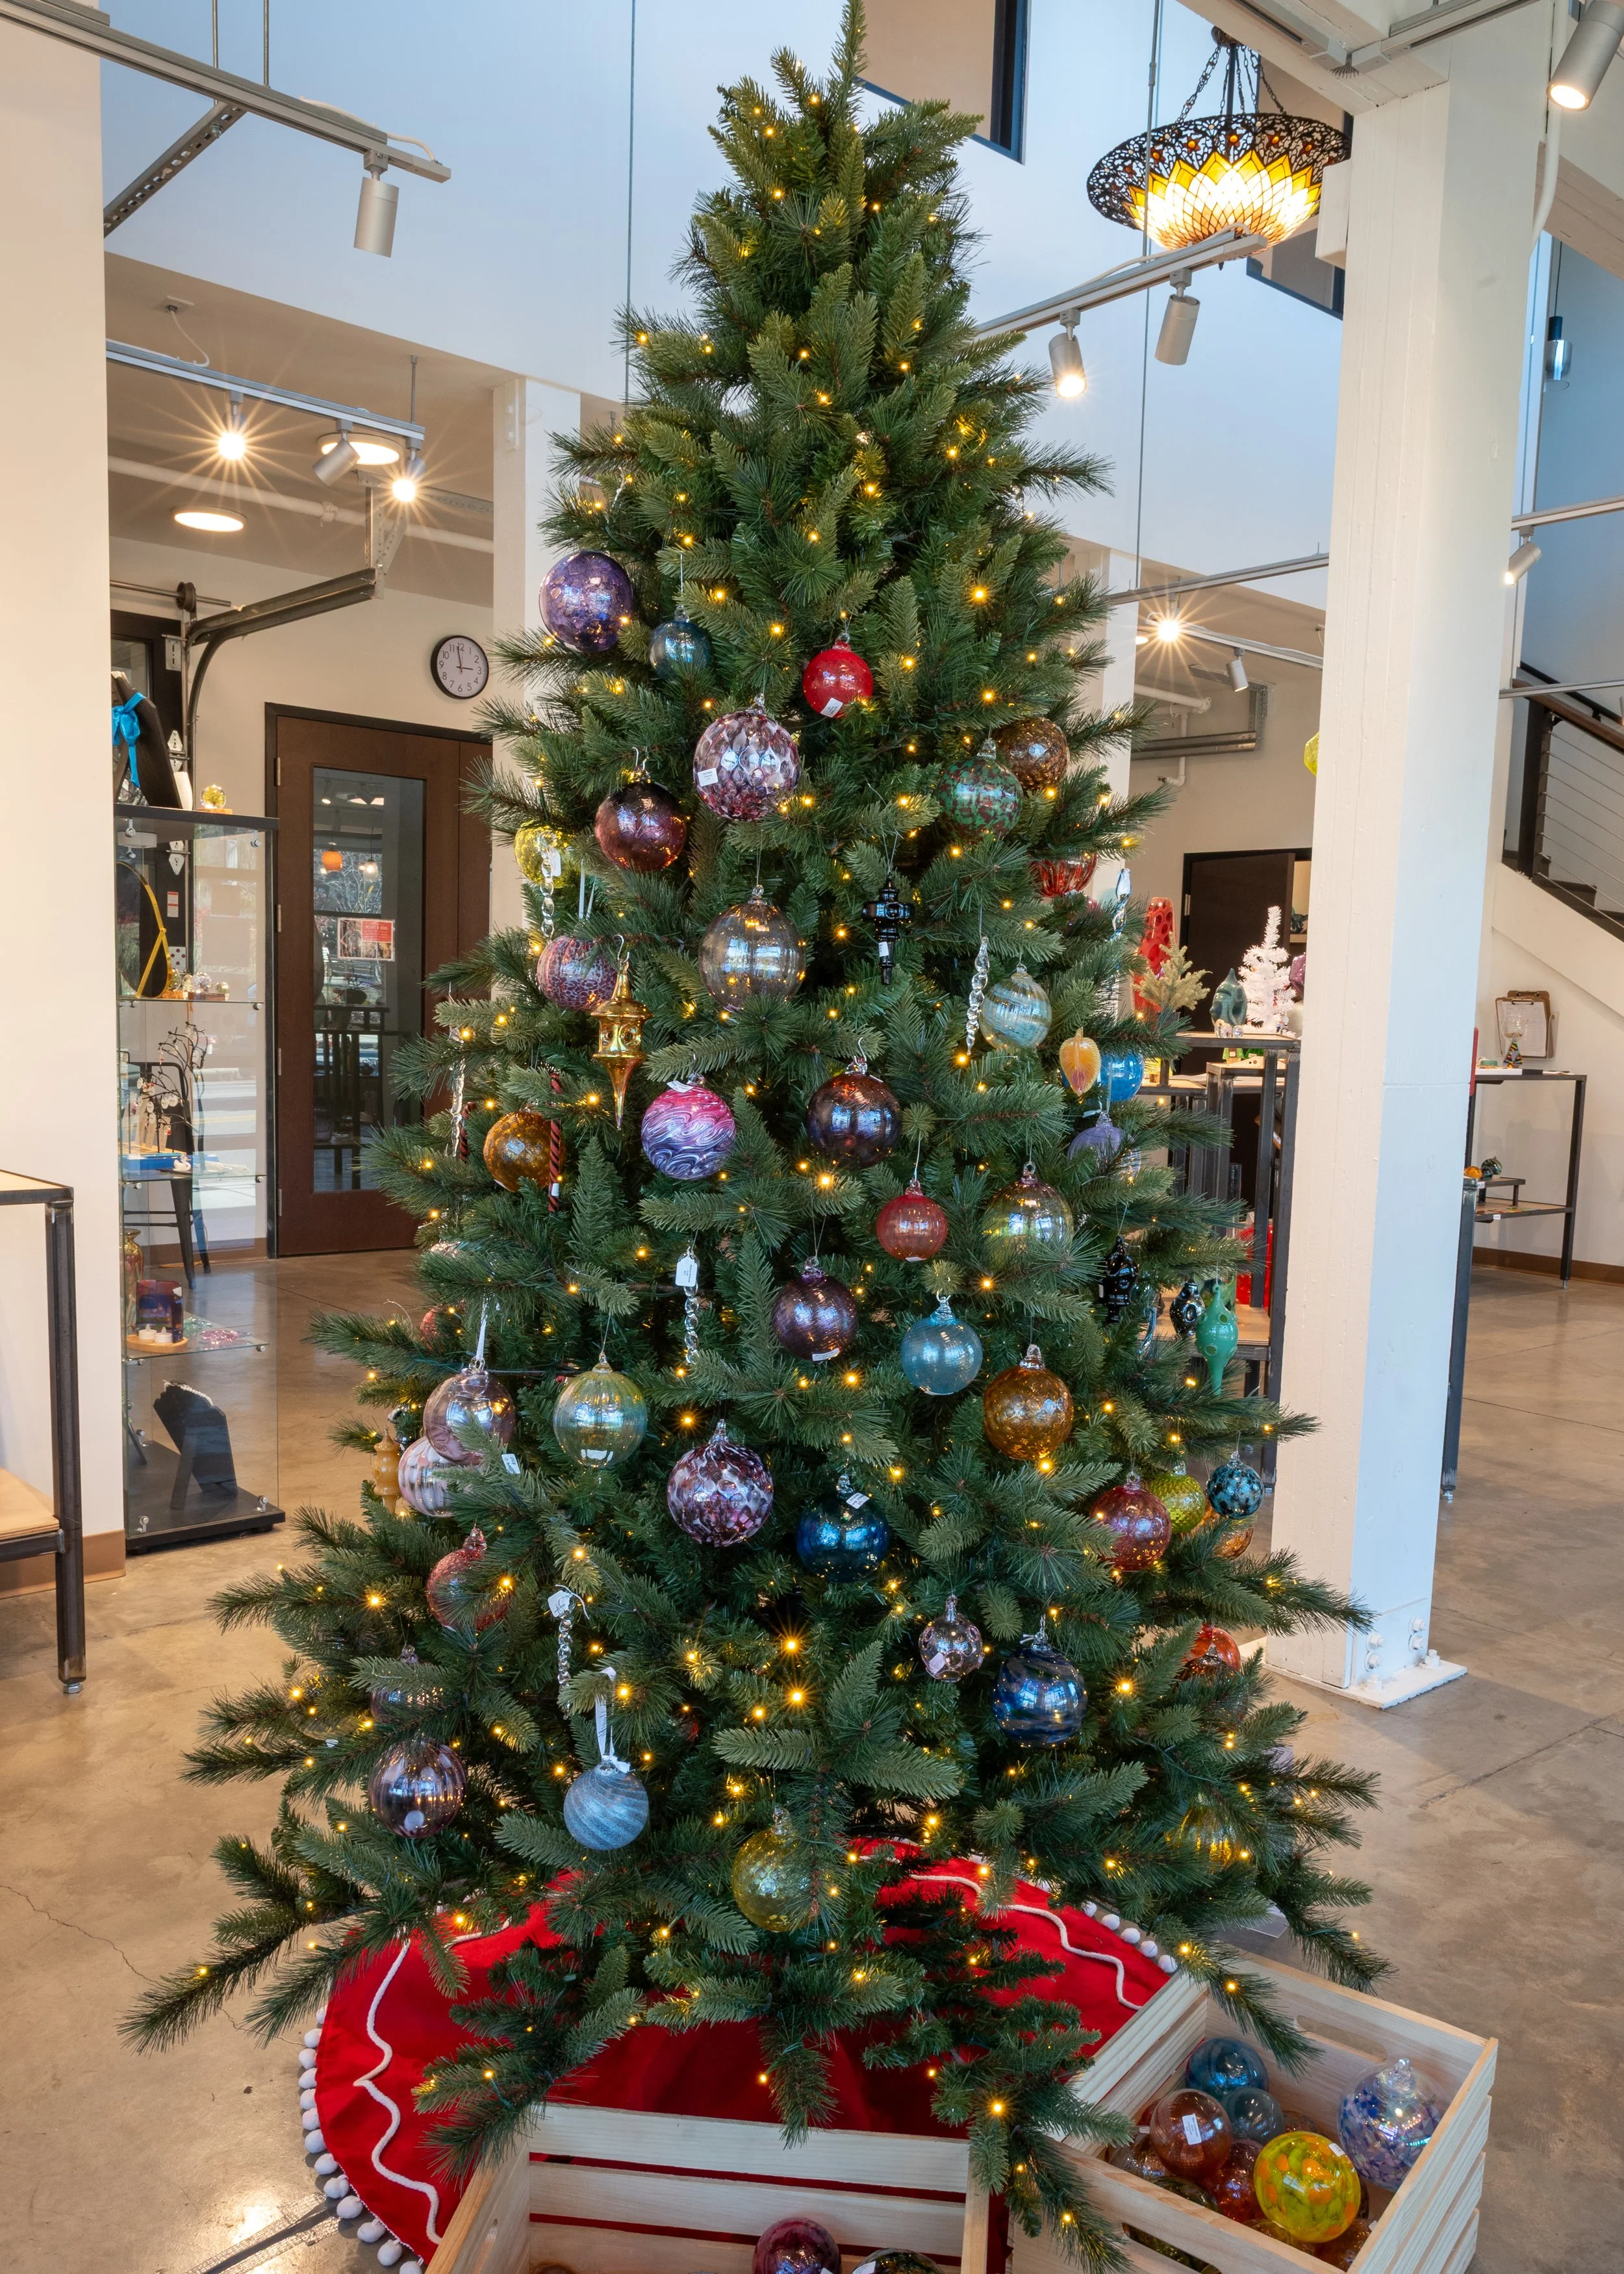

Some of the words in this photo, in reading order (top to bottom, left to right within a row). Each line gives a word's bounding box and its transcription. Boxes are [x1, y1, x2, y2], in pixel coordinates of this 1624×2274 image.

[450, 644, 454, 652] 11
[457, 643, 464, 651] 12
[442, 651, 449, 659] 10
